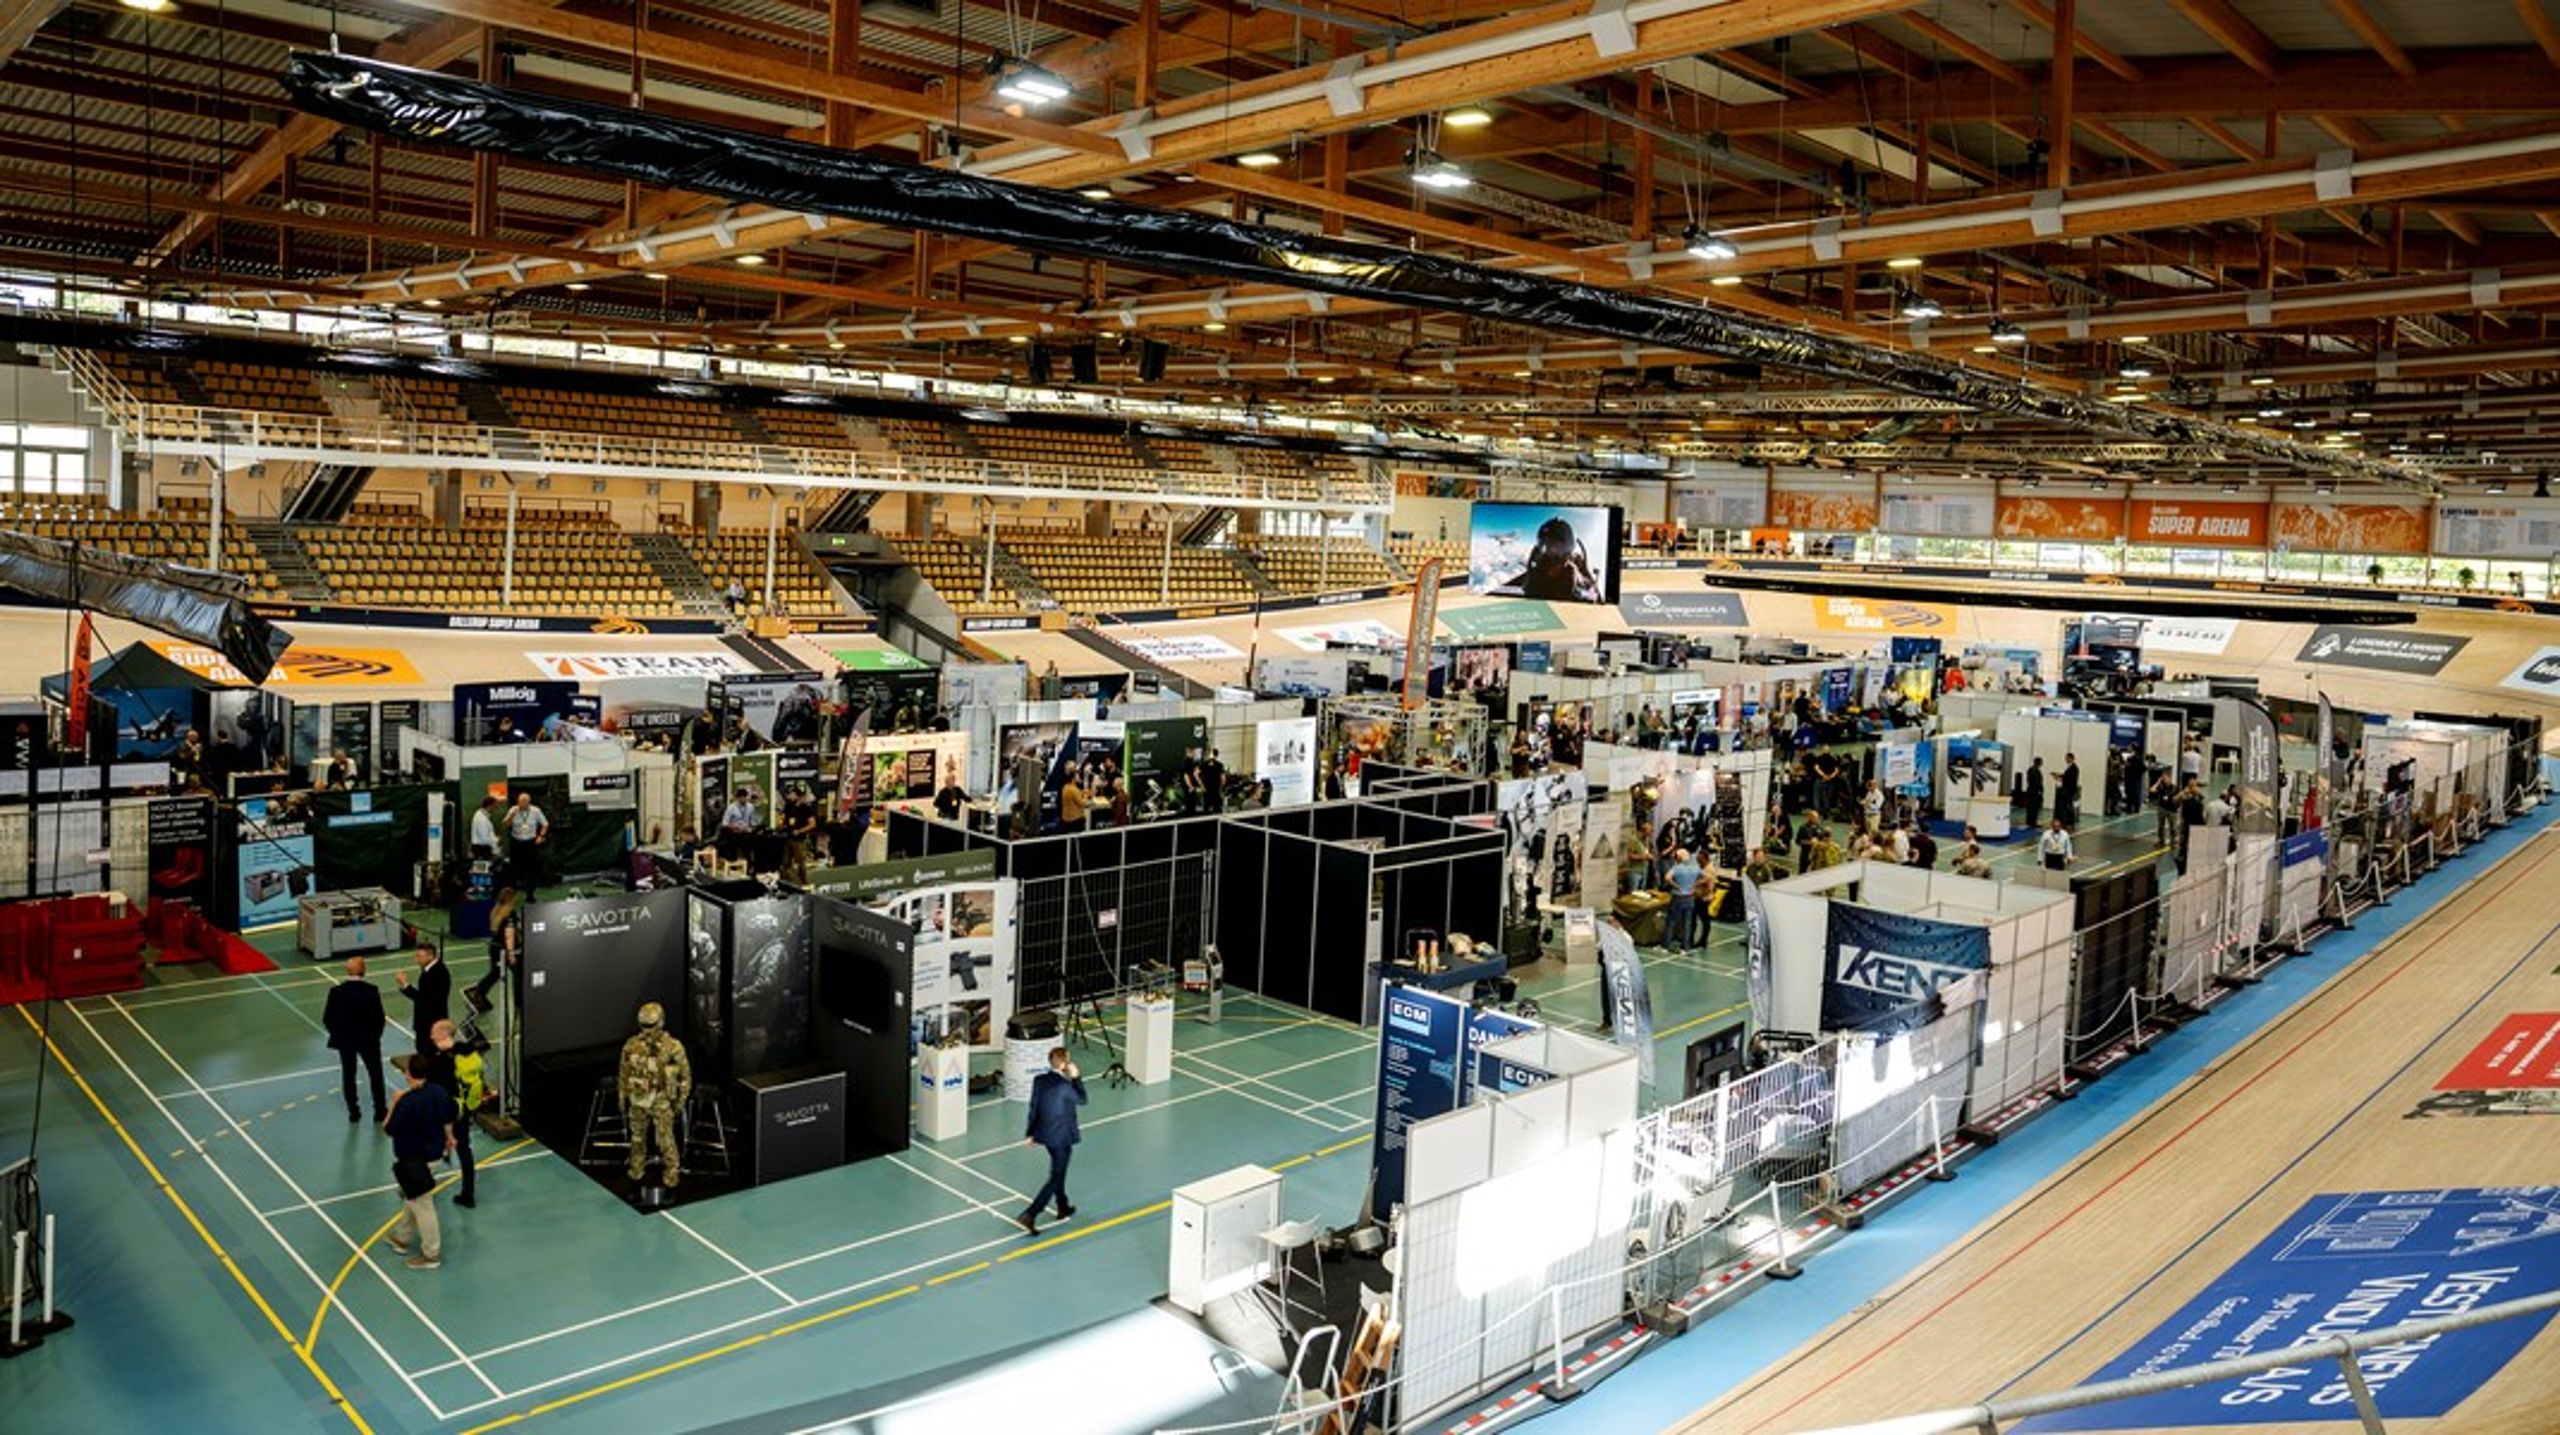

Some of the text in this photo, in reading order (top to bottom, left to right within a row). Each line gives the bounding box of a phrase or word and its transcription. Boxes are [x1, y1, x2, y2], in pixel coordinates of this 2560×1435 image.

[2148, 515, 2250, 536] SUPER ARENA
[600, 657, 730, 668] TEAM
[562, 905, 652, 930] SAVOTTA
[1393, 1003, 1428, 1024] ECM
[2219, 1366, 2313, 1407] A/S
